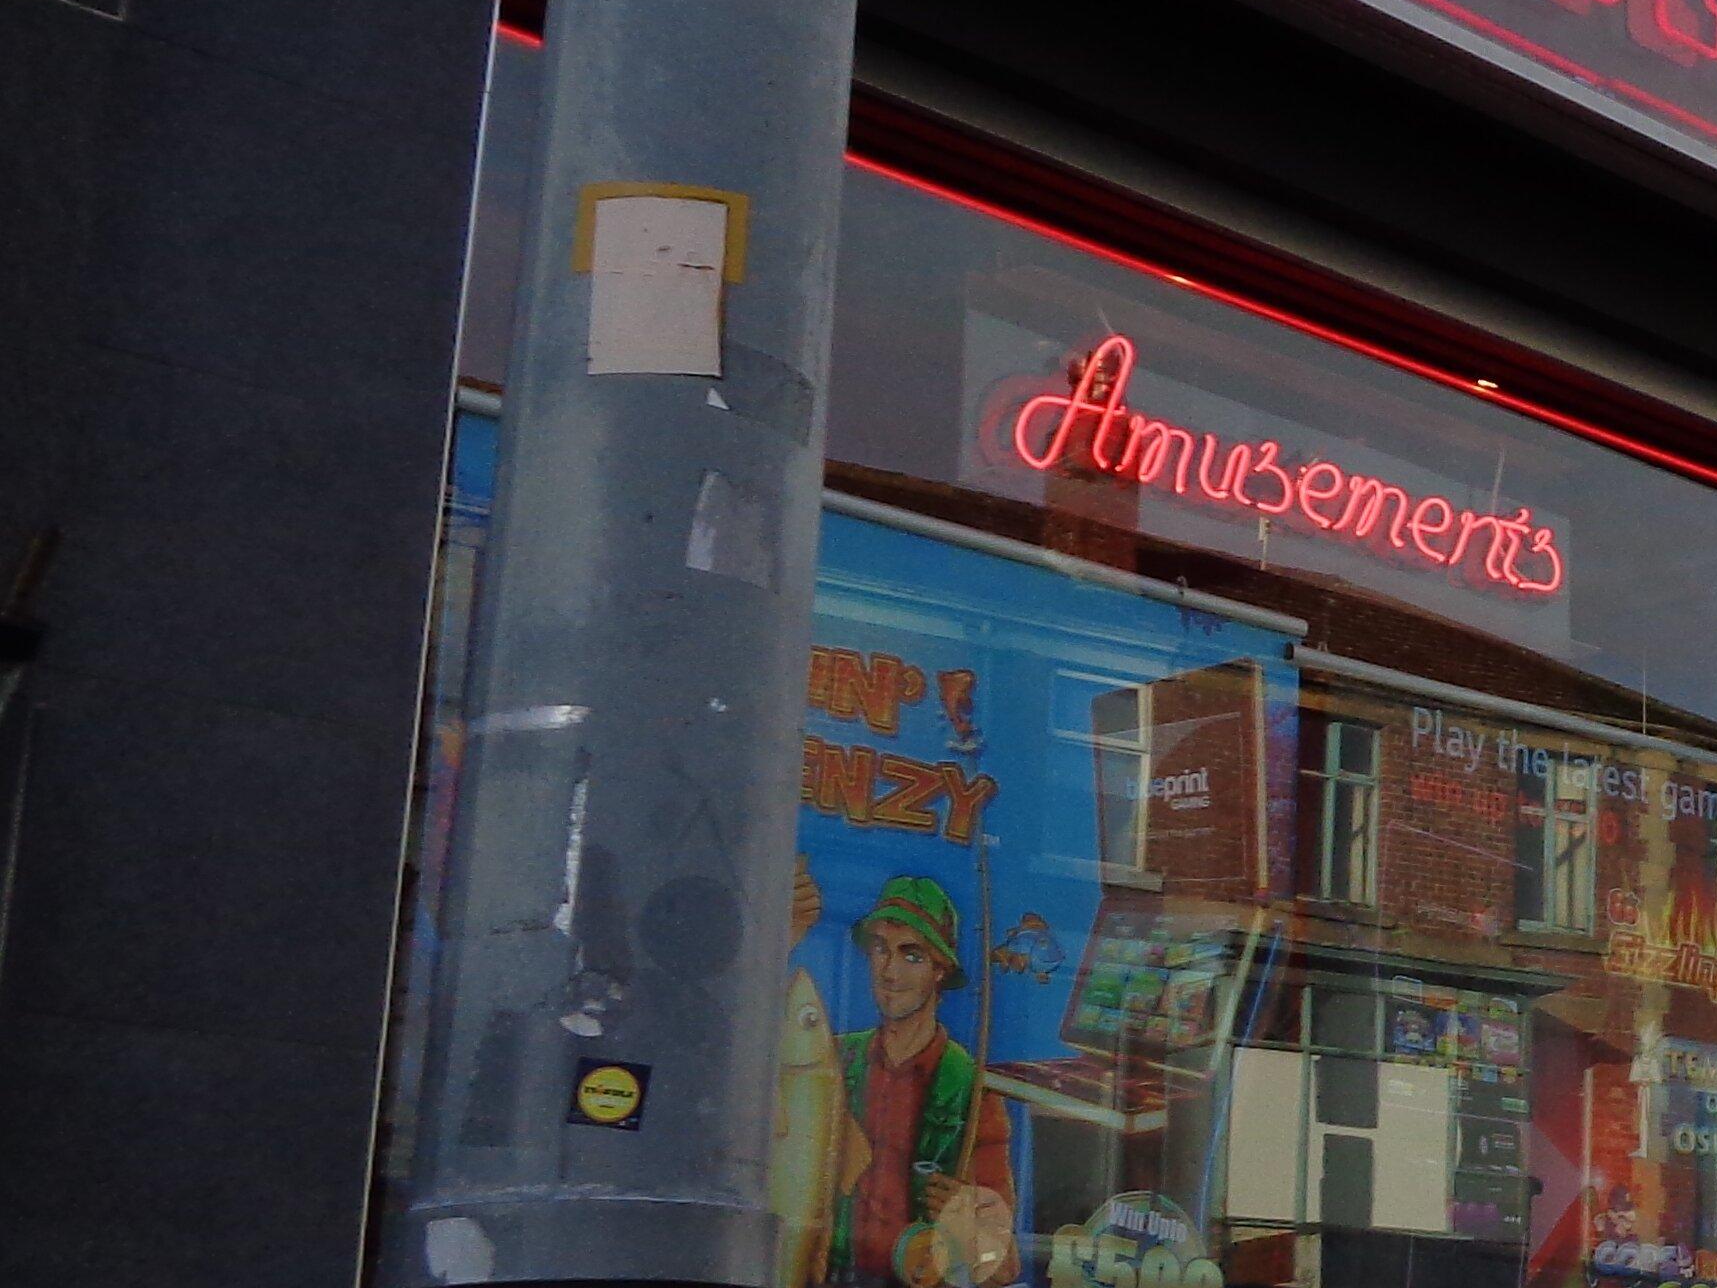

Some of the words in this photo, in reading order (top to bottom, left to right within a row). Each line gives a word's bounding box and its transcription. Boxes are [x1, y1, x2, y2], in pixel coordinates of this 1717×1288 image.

[1014, 332, 1563, 594] Amusements
[800, 735, 998, 849] ENZY
[1411, 707, 1487, 774] Play
[1498, 728, 1549, 778] the
[1561, 742, 1652, 804] latest
